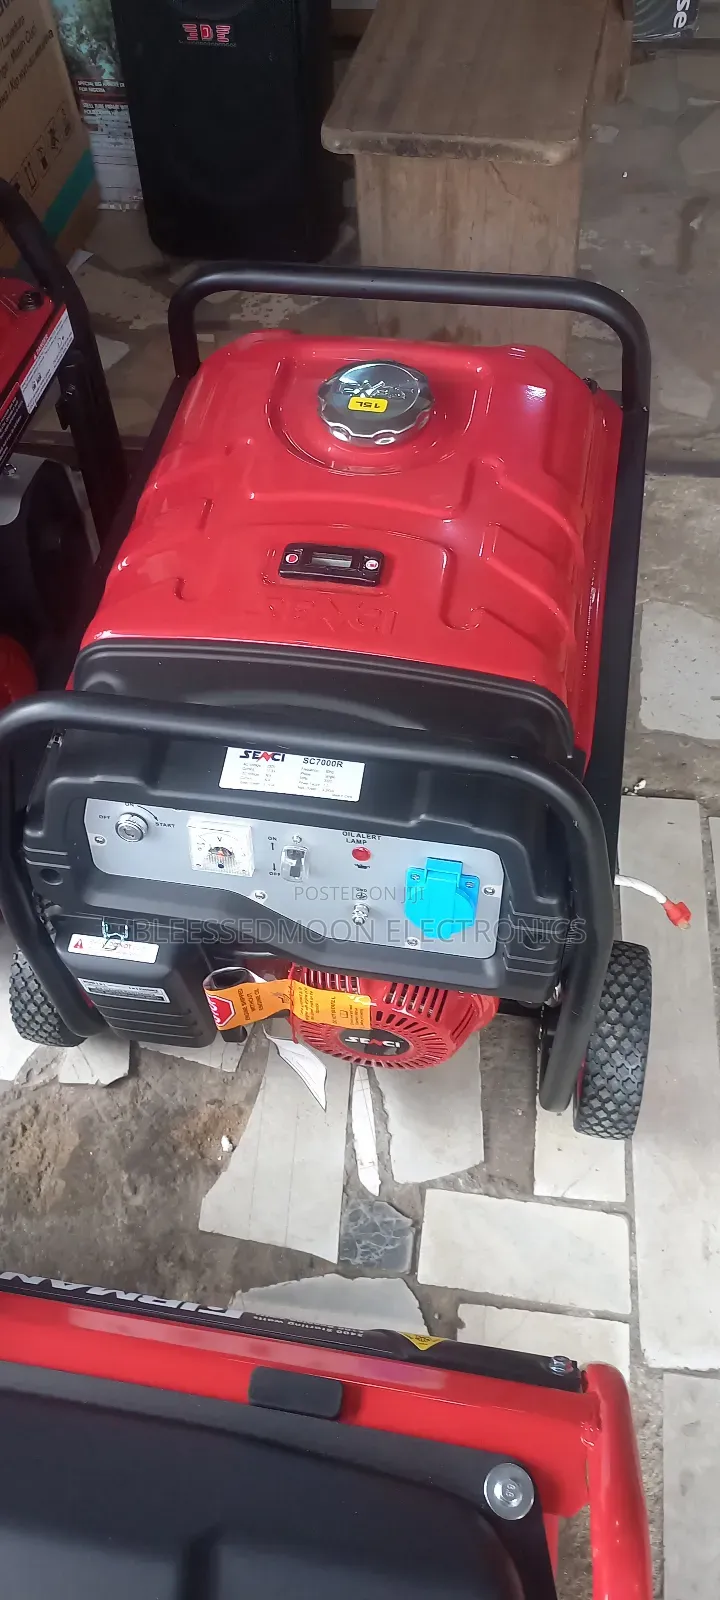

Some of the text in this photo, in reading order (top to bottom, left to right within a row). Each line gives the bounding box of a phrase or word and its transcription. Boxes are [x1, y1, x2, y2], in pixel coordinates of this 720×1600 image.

[355, 401, 381, 409] 15L
[239, 750, 344, 768] SENCI SC7000R
[355, 833, 382, 841] ALERT
[344, 1036, 401, 1048] SENCI
